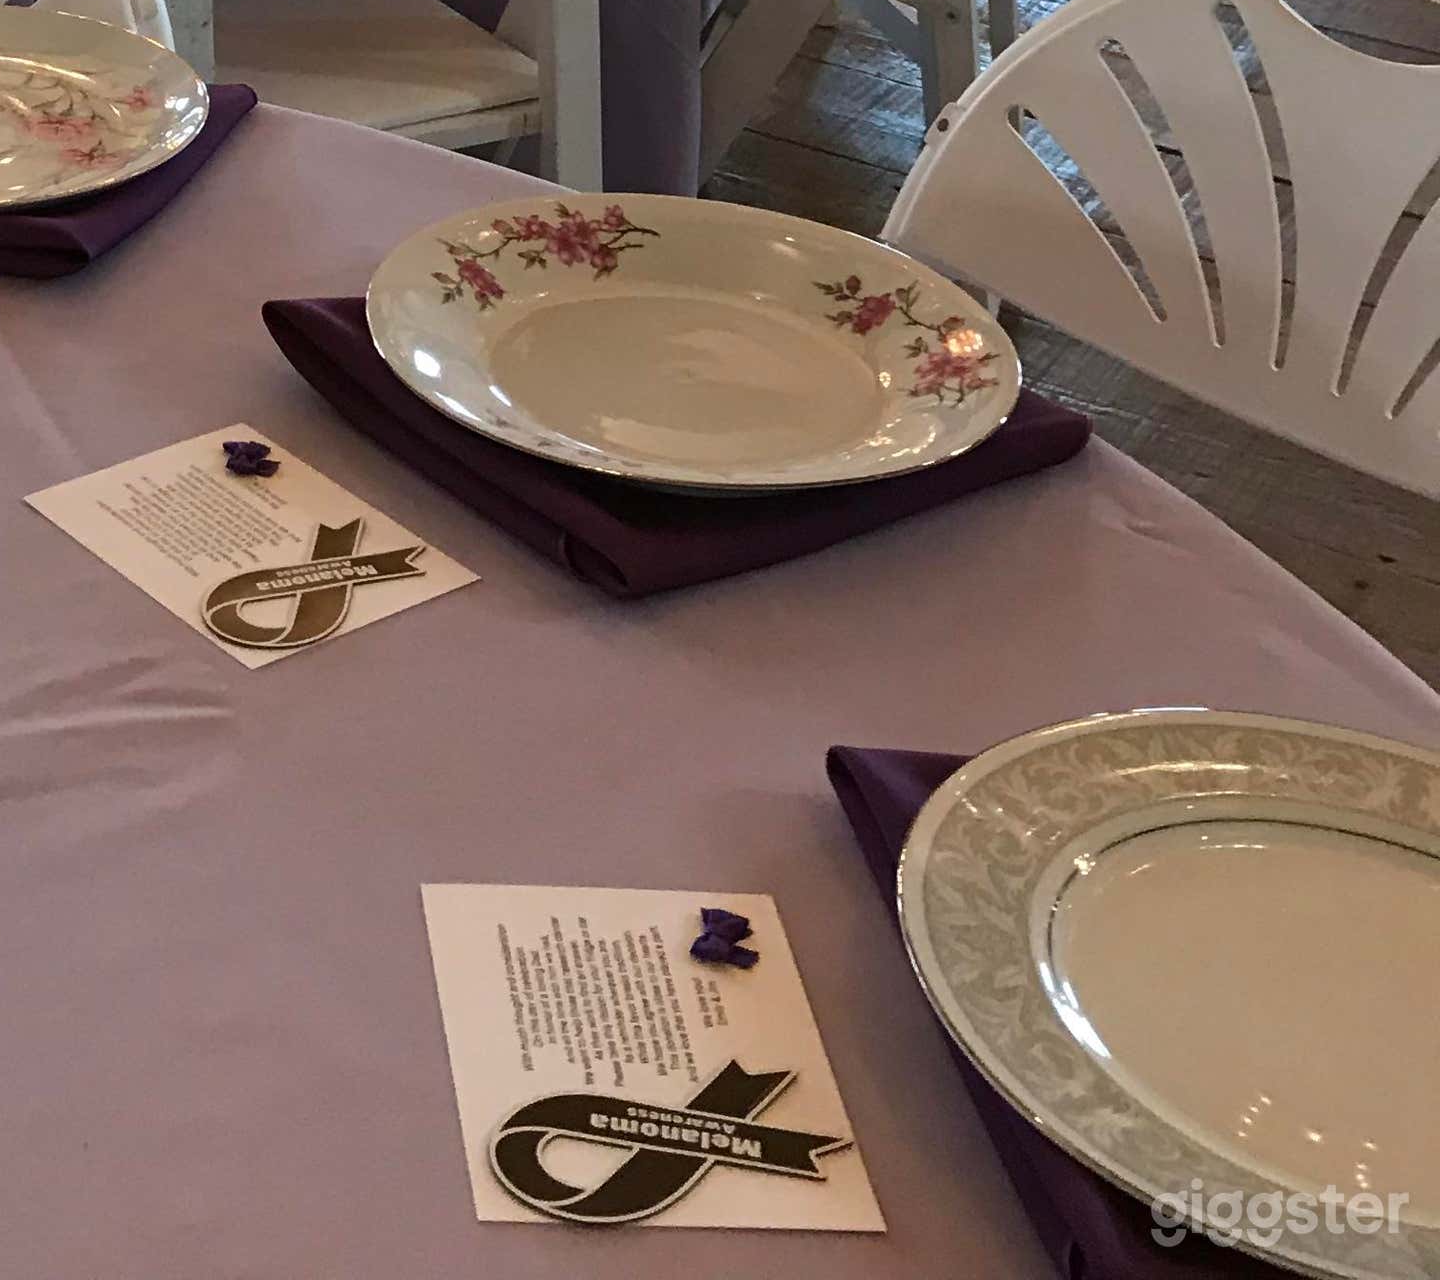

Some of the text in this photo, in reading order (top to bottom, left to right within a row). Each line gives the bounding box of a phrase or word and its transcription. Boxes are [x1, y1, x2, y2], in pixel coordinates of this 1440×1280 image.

[255, 564, 378, 591] Melanoma
[627, 1107, 736, 1134] Awareness
[590, 1112, 762, 1158] Melanoma
